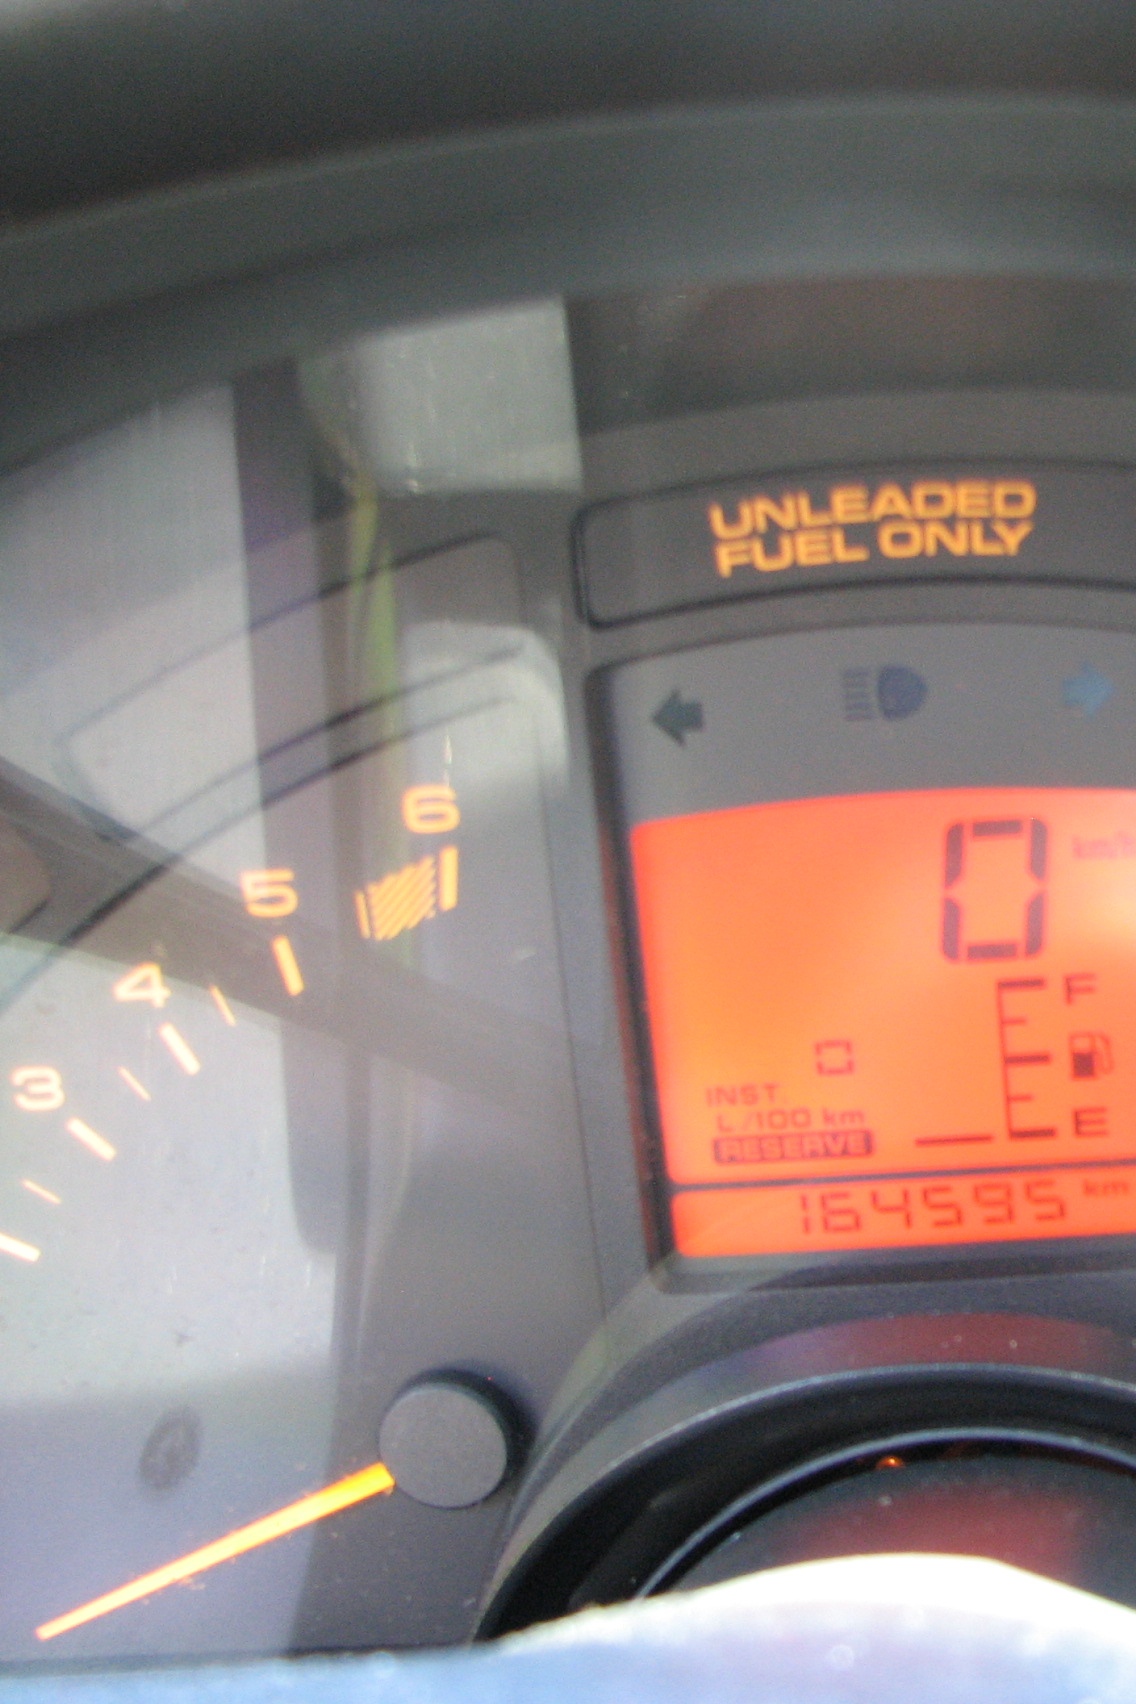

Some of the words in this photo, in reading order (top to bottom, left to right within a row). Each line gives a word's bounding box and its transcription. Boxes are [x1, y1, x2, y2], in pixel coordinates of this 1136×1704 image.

[709, 479, 1036, 541] UNLEADED
[716, 529, 869, 578] FUEL
[878, 521, 1032, 559] ONLY
[402, 784, 461, 834] 6
[240, 869, 298, 918] 5
[941, 817, 1048, 963] 0
[113, 962, 170, 1008] 4
[1064, 973, 1096, 1005] F
[11, 1065, 65, 1111] 3
[821, 1107, 865, 1128] km
[1074, 1107, 1107, 1137] E
[719, 1131, 864, 1162] RESERVE
[800, 1180, 1066, 1235] 164595
[1082, 1178, 1131, 1199] km
